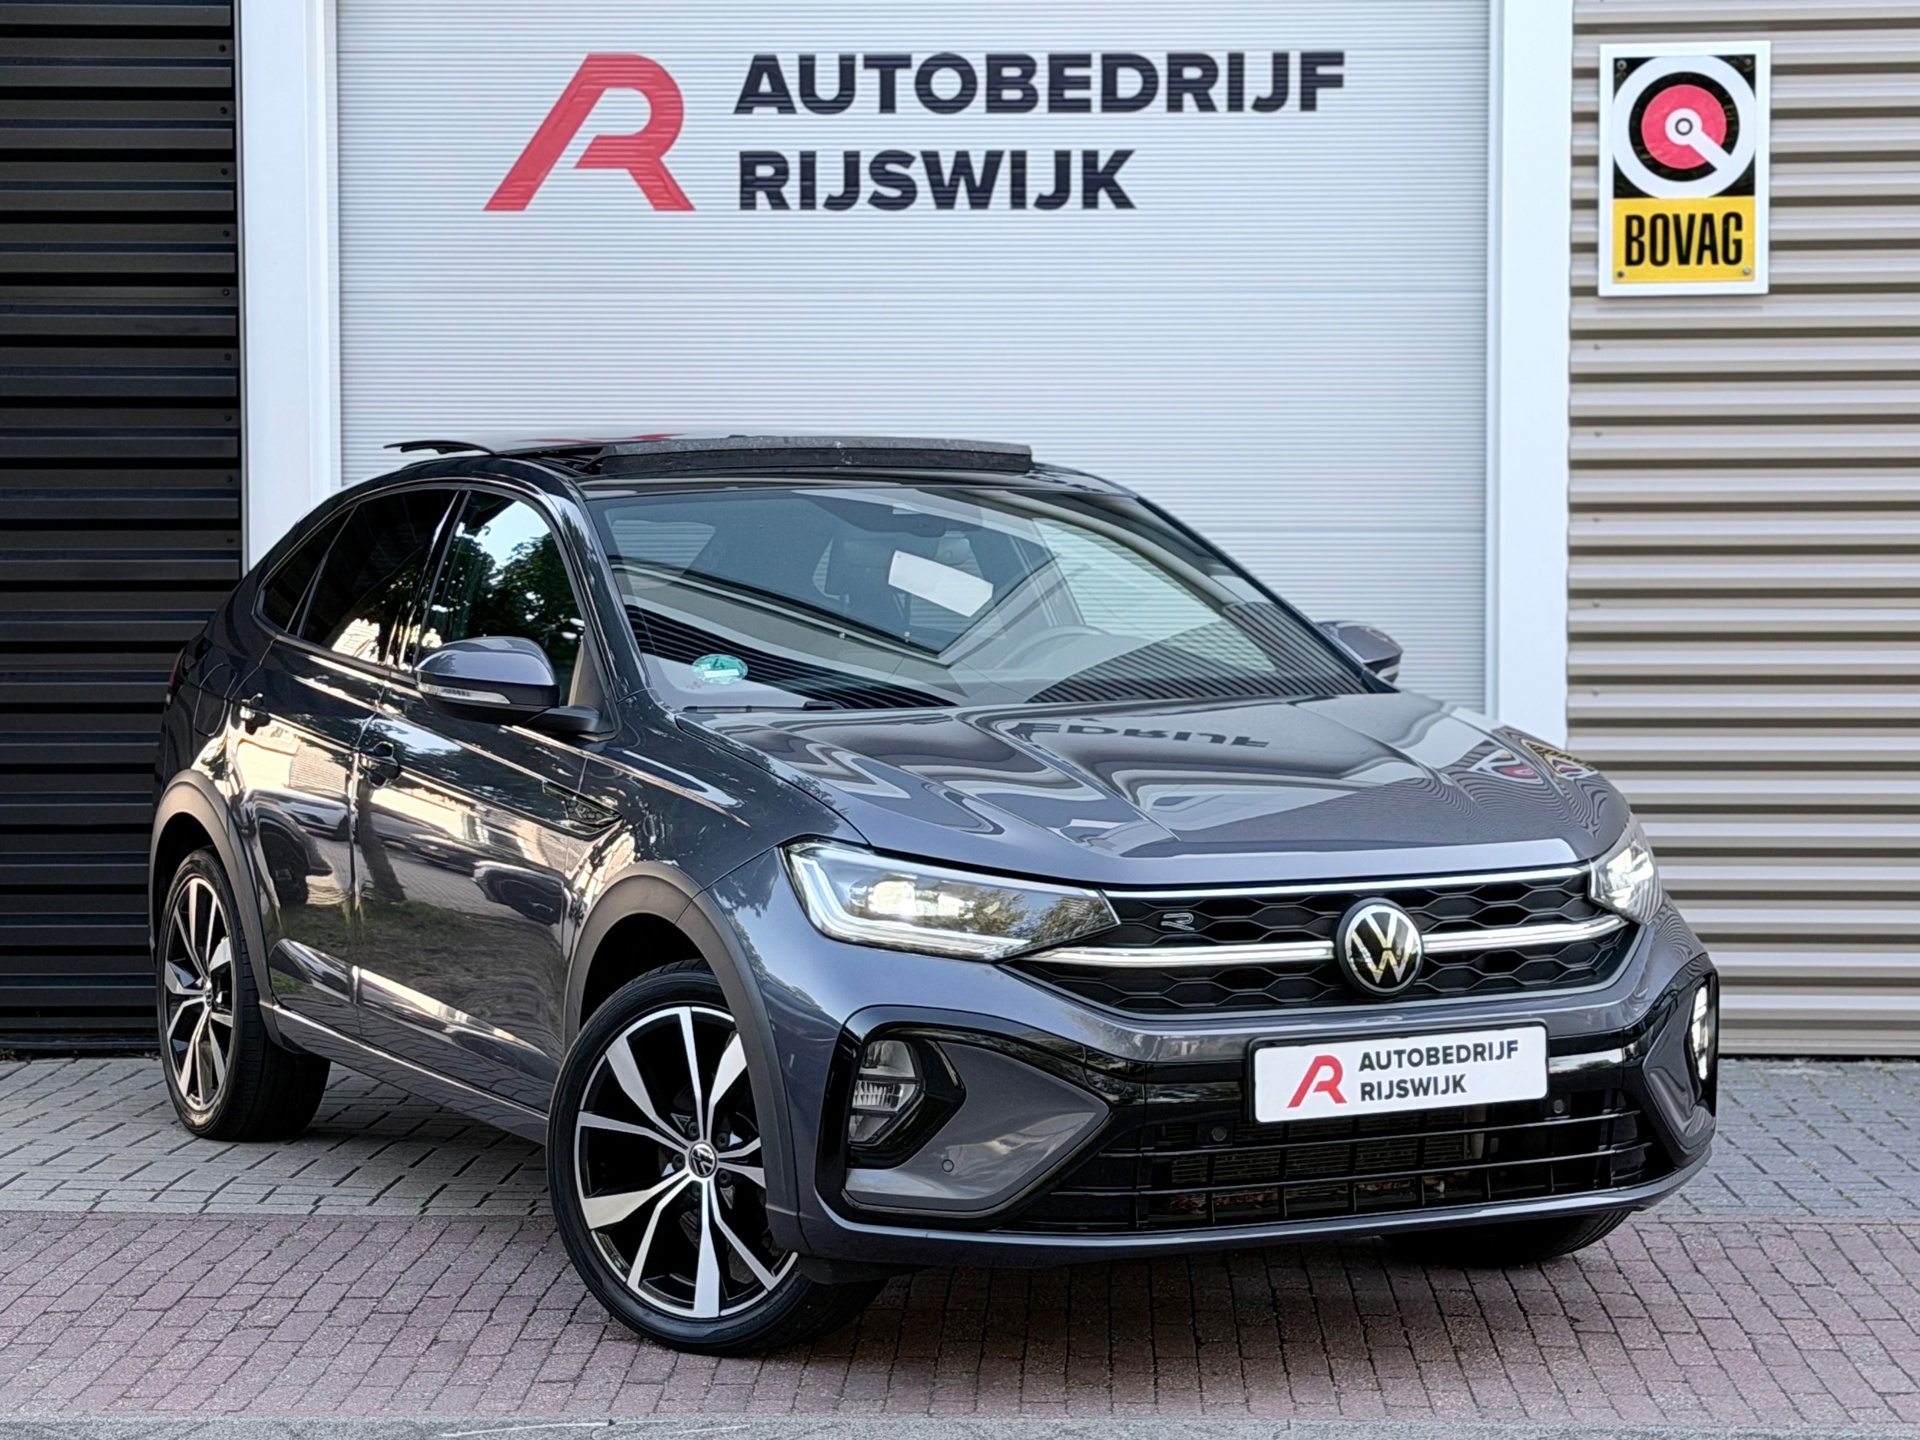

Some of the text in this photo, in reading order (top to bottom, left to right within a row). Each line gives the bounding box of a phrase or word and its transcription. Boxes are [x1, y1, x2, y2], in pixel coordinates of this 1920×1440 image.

[734, 51, 1345, 115] AUTOBEDRIJF
[738, 149, 1136, 211] RIJSWIJK
[1624, 211, 1744, 267] BOVAG
[1358, 1039, 1519, 1072] AUTOBEDRIJF
[1359, 1074, 1467, 1102] RIJSWIJK
